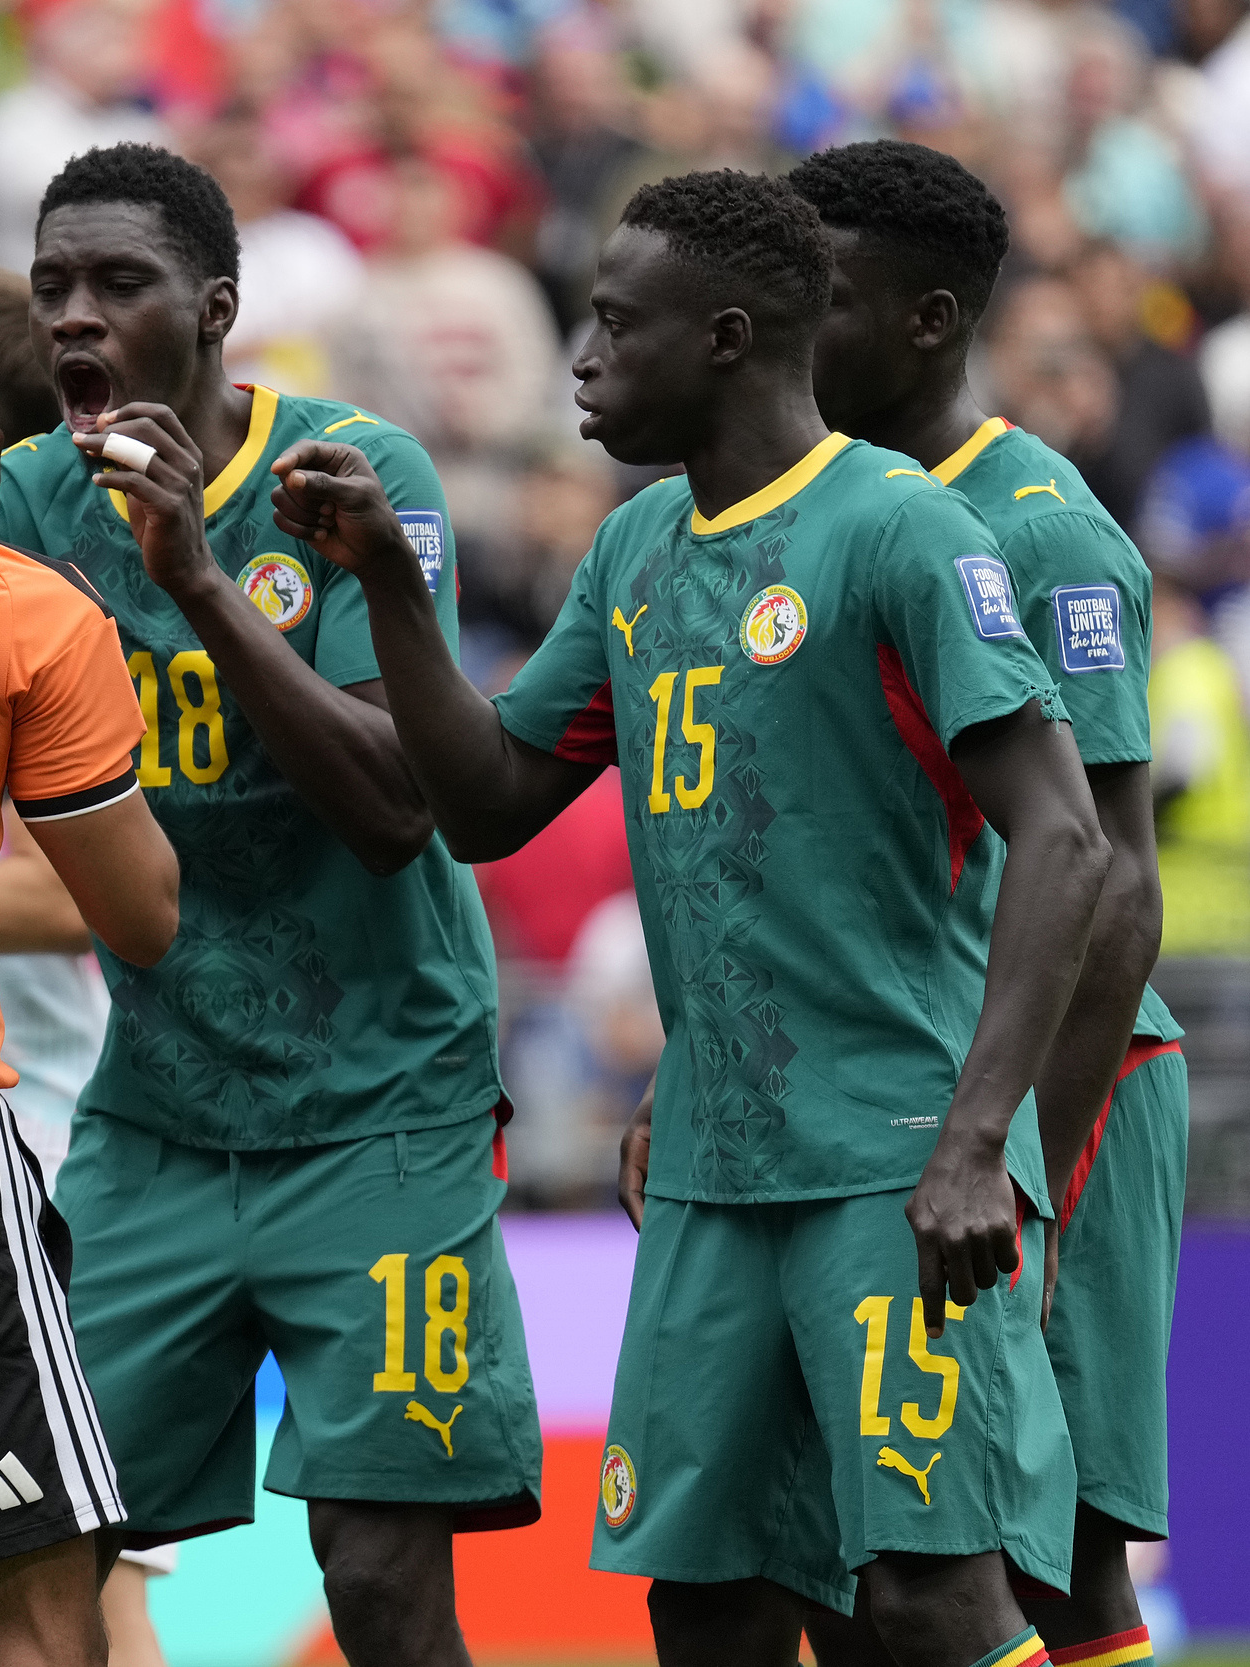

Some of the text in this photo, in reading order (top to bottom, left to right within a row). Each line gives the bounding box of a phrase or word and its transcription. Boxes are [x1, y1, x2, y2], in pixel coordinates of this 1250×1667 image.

[400, 523, 440, 536] OOTBALL
[407, 537, 441, 555] NITES
[254, 554, 307, 579] SÉNÉGALAISE
[977, 580, 1006, 600] UNES
[769, 588, 805, 620] SÉNÉGALAISE
[980, 599, 1000, 615] the
[1067, 598, 1112, 613] FOOTBALL
[277, 605, 307, 629] FOOTBAL
[740, 598, 760, 649] FÉDÉRATION
[1070, 612, 1113, 632] UNITES
[756, 633, 802, 662] DE FOOTBALL
[1069, 630, 1116, 649] the World
[1087, 648, 1108, 657] FIFA
[127, 650, 229, 788] 18
[648, 665, 725, 814] 15
[891, 1116, 938, 1126] ULTRAWEAVE
[368, 1253, 470, 1393] 18
[853, 1296, 968, 1440] 15
